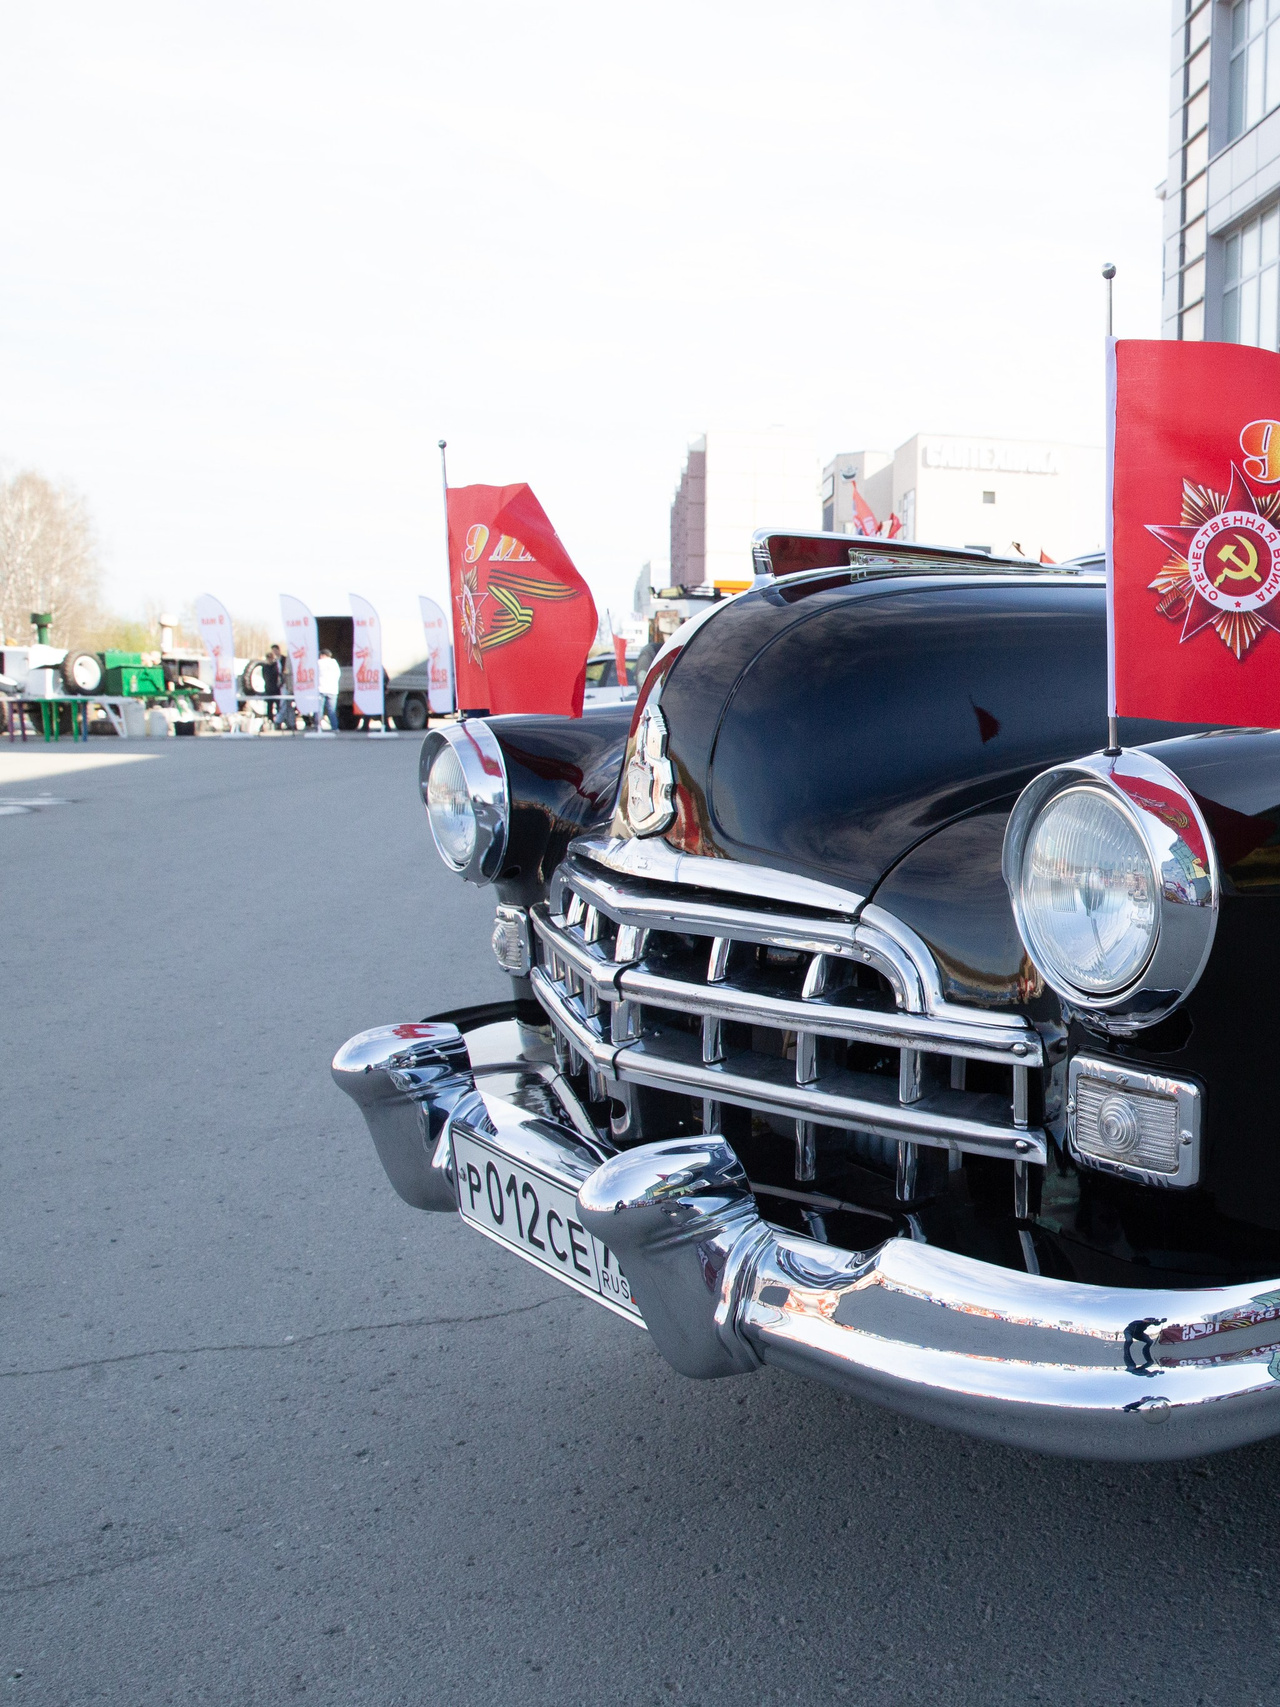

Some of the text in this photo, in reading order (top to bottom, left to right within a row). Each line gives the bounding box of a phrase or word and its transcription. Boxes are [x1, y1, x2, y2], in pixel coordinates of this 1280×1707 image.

[464, 523, 537, 564] 9 М
[1191, 515, 1278, 601] ОТЕЧЕСТВЕННАЯ
[601, 1269, 630, 1300] RUS
